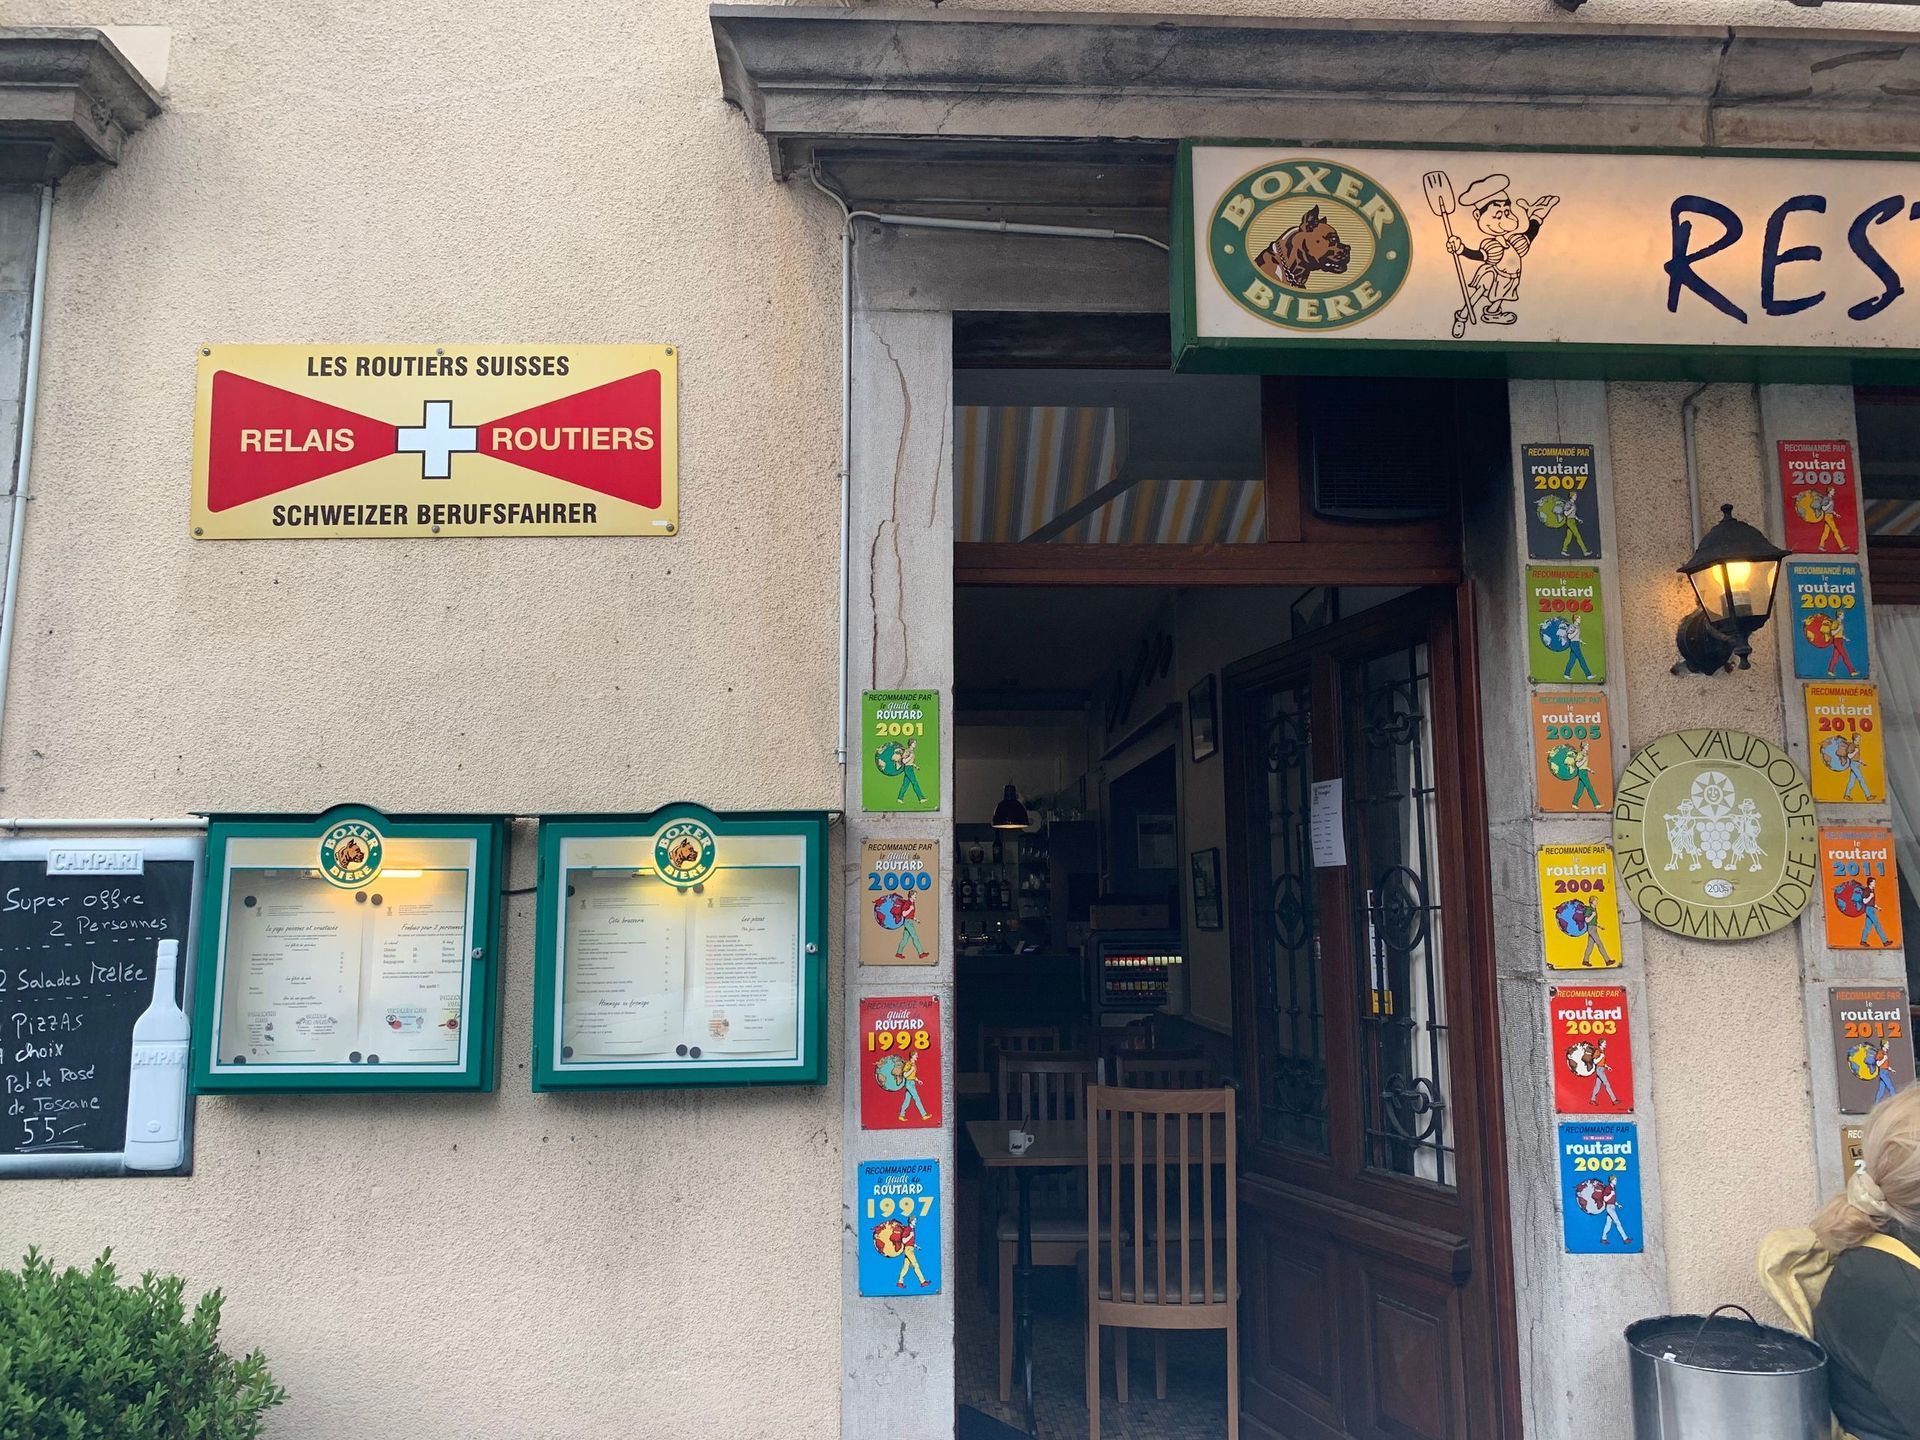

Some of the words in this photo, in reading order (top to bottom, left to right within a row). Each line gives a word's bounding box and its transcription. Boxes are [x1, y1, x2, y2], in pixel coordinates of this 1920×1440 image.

[1220, 165, 1395, 240] BOXER
[1663, 195, 1920, 324] RES
[1242, 277, 1383, 323] BIERE
[307, 356, 347, 377] LES
[356, 355, 468, 377] ROUTIERS
[476, 355, 570, 377] SUISSES
[240, 428, 355, 452] RELAIS
[492, 427, 654, 451] ROUTIERS
[1577, 448, 1590, 456] PAR
[1531, 463, 1589, 475] routard
[1788, 459, 1846, 470] routard
[1535, 475, 1588, 490] 2007
[1792, 471, 1846, 485] 2008
[272, 504, 408, 526] SCHWEIZER
[417, 503, 597, 525] BERUFSFAHRER
[1535, 586, 1593, 597] routard
[1798, 582, 1856, 593] routard
[1539, 598, 1594, 613] 2006
[1801, 594, 1856, 609] 2009
[918, 693, 932, 701] PAR
[887, 701, 910, 711] guide
[1815, 704, 1873, 716] routard
[876, 710, 923, 720] ROUTARD
[1541, 712, 1601, 723] routard
[875, 722, 924, 736] 2001
[1819, 716, 1873, 732] 2010
[1546, 725, 1601, 740] 2005
[1616, 743, 1668, 823] PINTE
[1677, 730, 1815, 828] VAUDOISE
[324, 825, 379, 851] BOXER
[658, 824, 711, 851] BOXER
[918, 843, 932, 851] PAR
[1592, 846, 1605, 854] PAR
[1828, 848, 1887, 860] routard
[54, 852, 139, 871] CAMPARI
[887, 852, 910, 861] guide
[330, 865, 372, 881] BIERE
[664, 863, 706, 880] BIERE
[875, 860, 924, 871] ROUTARD
[1546, 863, 1607, 876] routard
[1833, 861, 1885, 876] 2011
[868, 871, 932, 891] 2000
[1554, 878, 1605, 893] 2004
[2, 887, 70, 914] Super
[50, 921, 65, 936] 2
[76, 916, 168, 934] Personnes
[17, 969, 81, 991] Salades
[1585, 998, 1593, 1006] le
[887, 1009, 911, 1020] guide
[1558, 1006, 1622, 1020] routard
[1840, 1007, 1901, 1020] routard
[875, 1019, 924, 1031] ROUTARD
[1566, 1020, 1617, 1035] 2003
[1844, 1022, 1902, 1038] 2012
[868, 1030, 930, 1051] 1998
[15, 1040, 64, 1062] choix
[6, 1071, 32, 1094] Pot
[36, 1069, 51, 1088] de
[60, 1064, 95, 1083] Rosé
[8, 1098, 26, 1116] de
[33, 1096, 101, 1114] Toscane
[1565, 1140, 1632, 1155] routard
[918, 1164, 932, 1173] PAR
[1574, 1157, 1627, 1171] 2002
[885, 1173, 909, 1184] guide
[873, 1184, 923, 1195] ROUTARD
[867, 1196, 934, 1218] 1997
